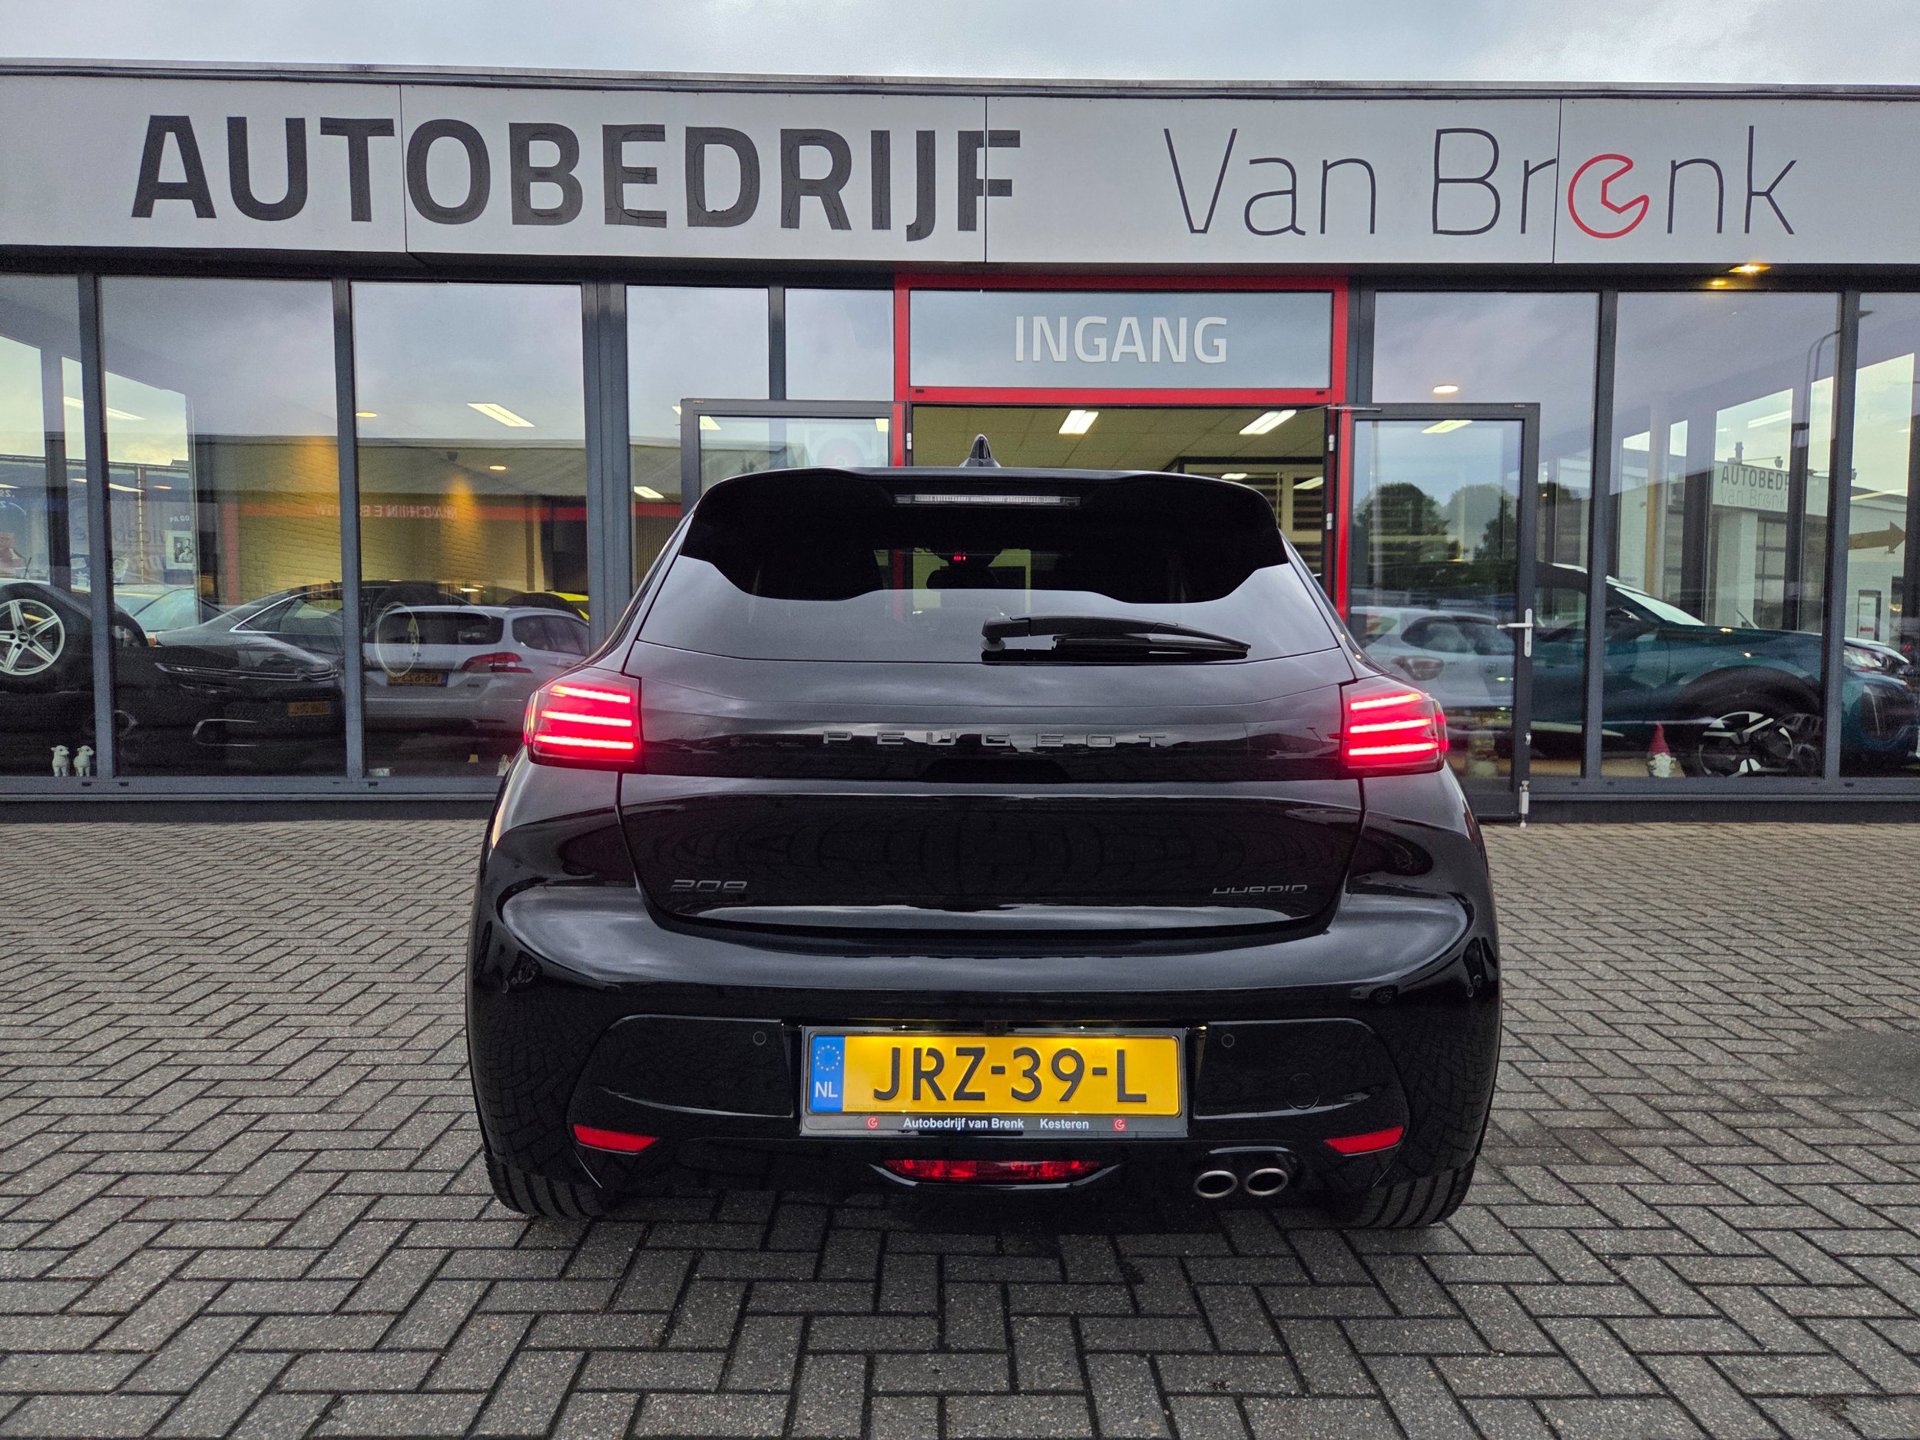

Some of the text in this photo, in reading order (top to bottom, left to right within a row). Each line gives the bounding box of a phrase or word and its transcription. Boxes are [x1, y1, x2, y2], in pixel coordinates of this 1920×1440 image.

[131, 114, 1021, 243] AUTOBEDRIJF
[1163, 127, 1377, 236] Van
[1015, 315, 1228, 364] INGANG
[822, 730, 1167, 749] PEUGEOT
[814, 1081, 839, 1098] NL
[873, 1046, 1147, 1103] JRZ-39-L
[903, 1117, 1090, 1131] Autobedrijf van Brenk Kesteren
